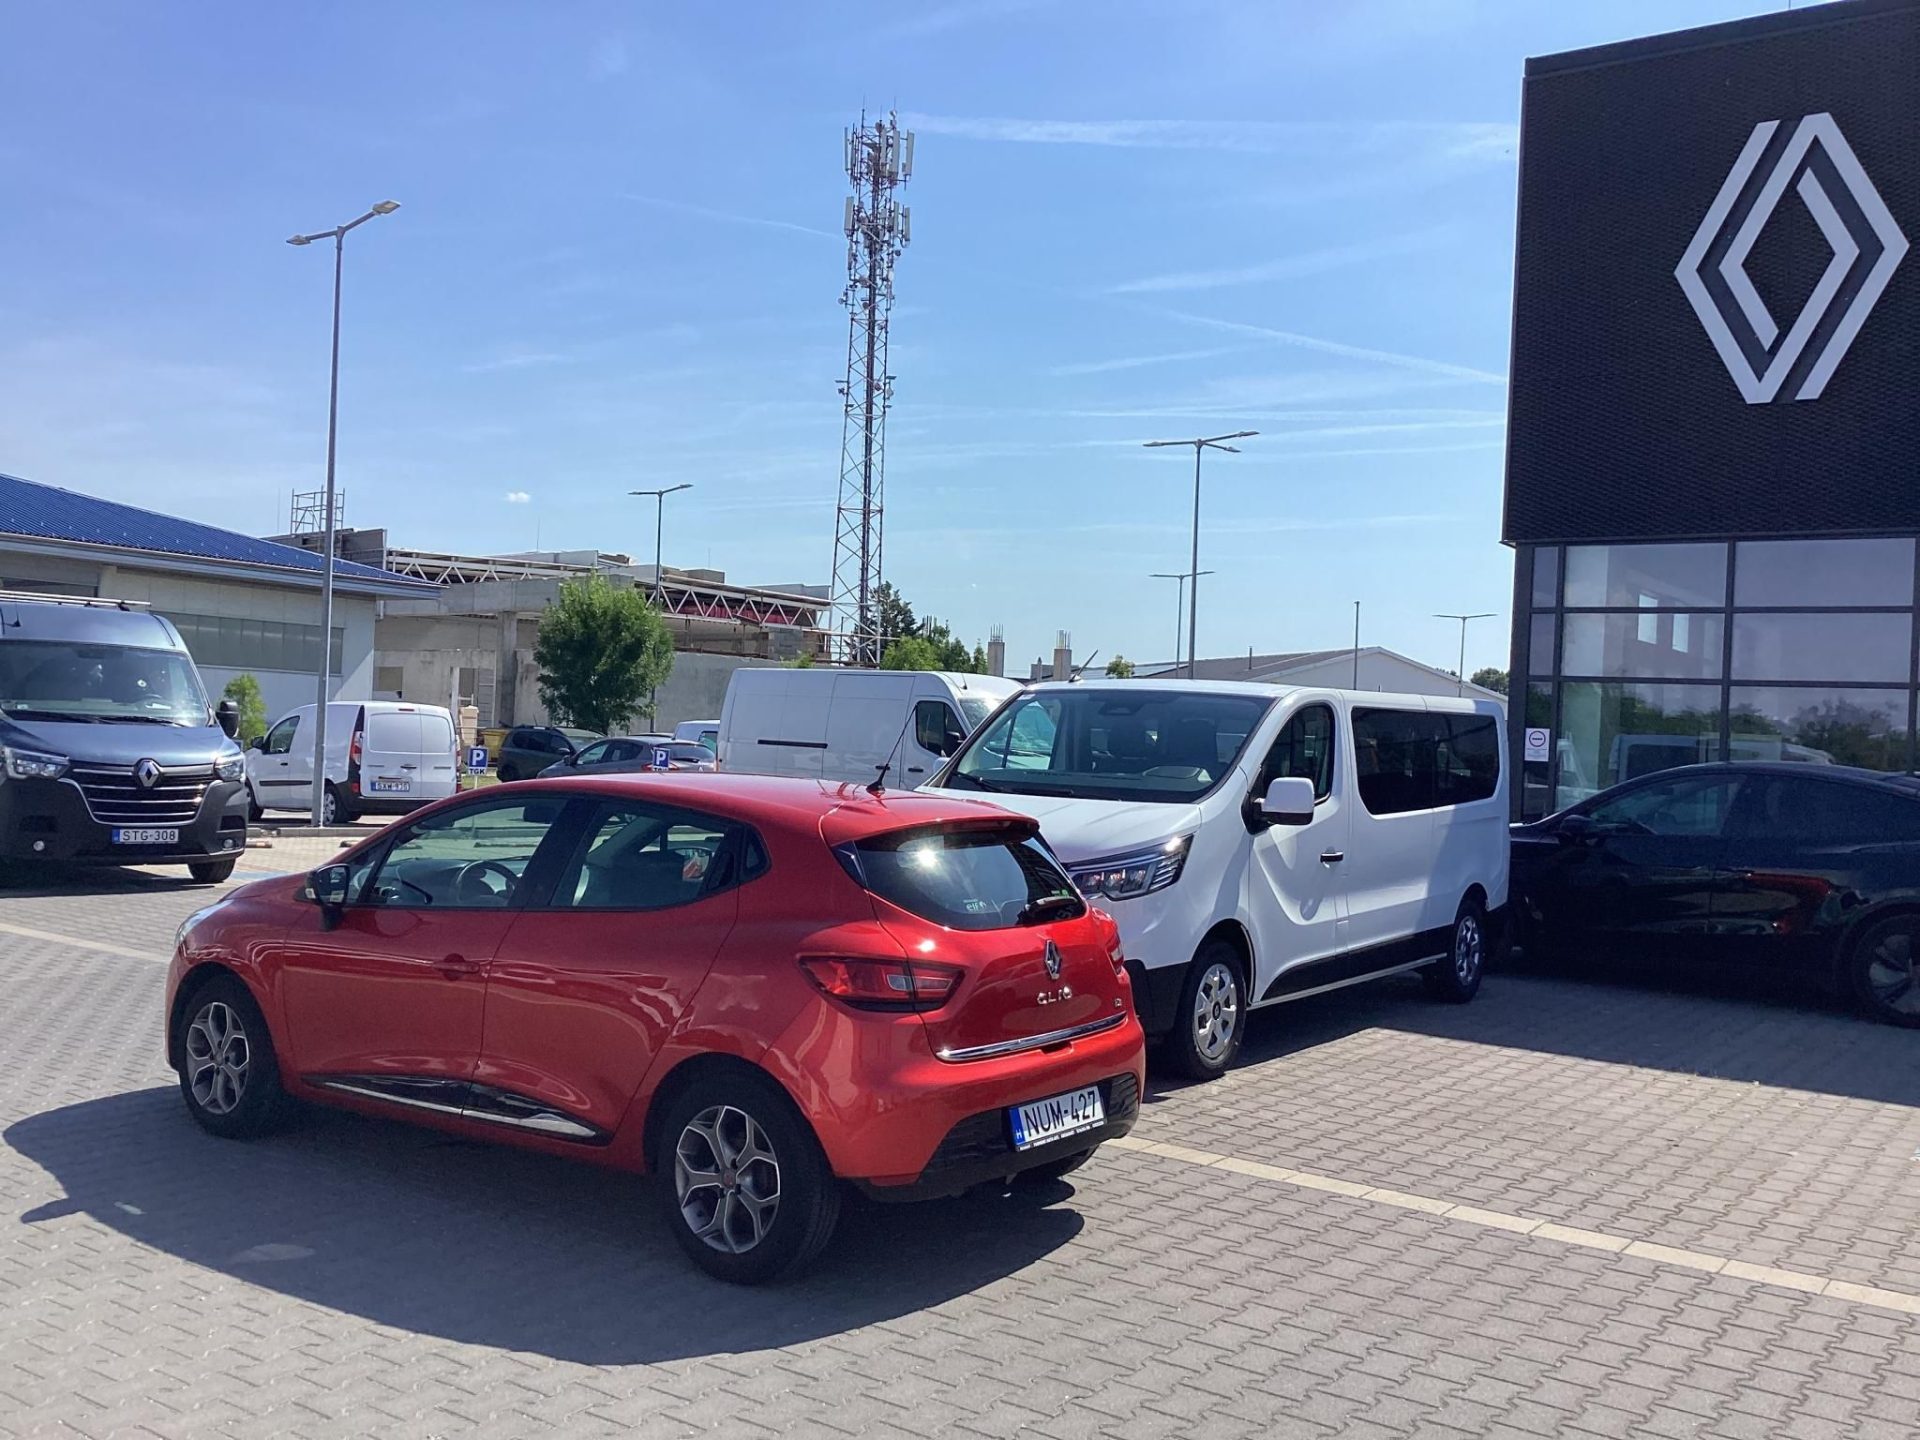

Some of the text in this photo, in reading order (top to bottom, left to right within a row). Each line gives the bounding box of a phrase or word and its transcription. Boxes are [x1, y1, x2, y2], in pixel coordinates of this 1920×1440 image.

[472, 750, 485, 765] P
[656, 750, 666, 766] P
[122, 830, 176, 841] STG-308
[966, 902, 979, 911] elf
[1037, 986, 1072, 1004] CLIO
[1023, 1089, 1096, 1137] NUM-427
